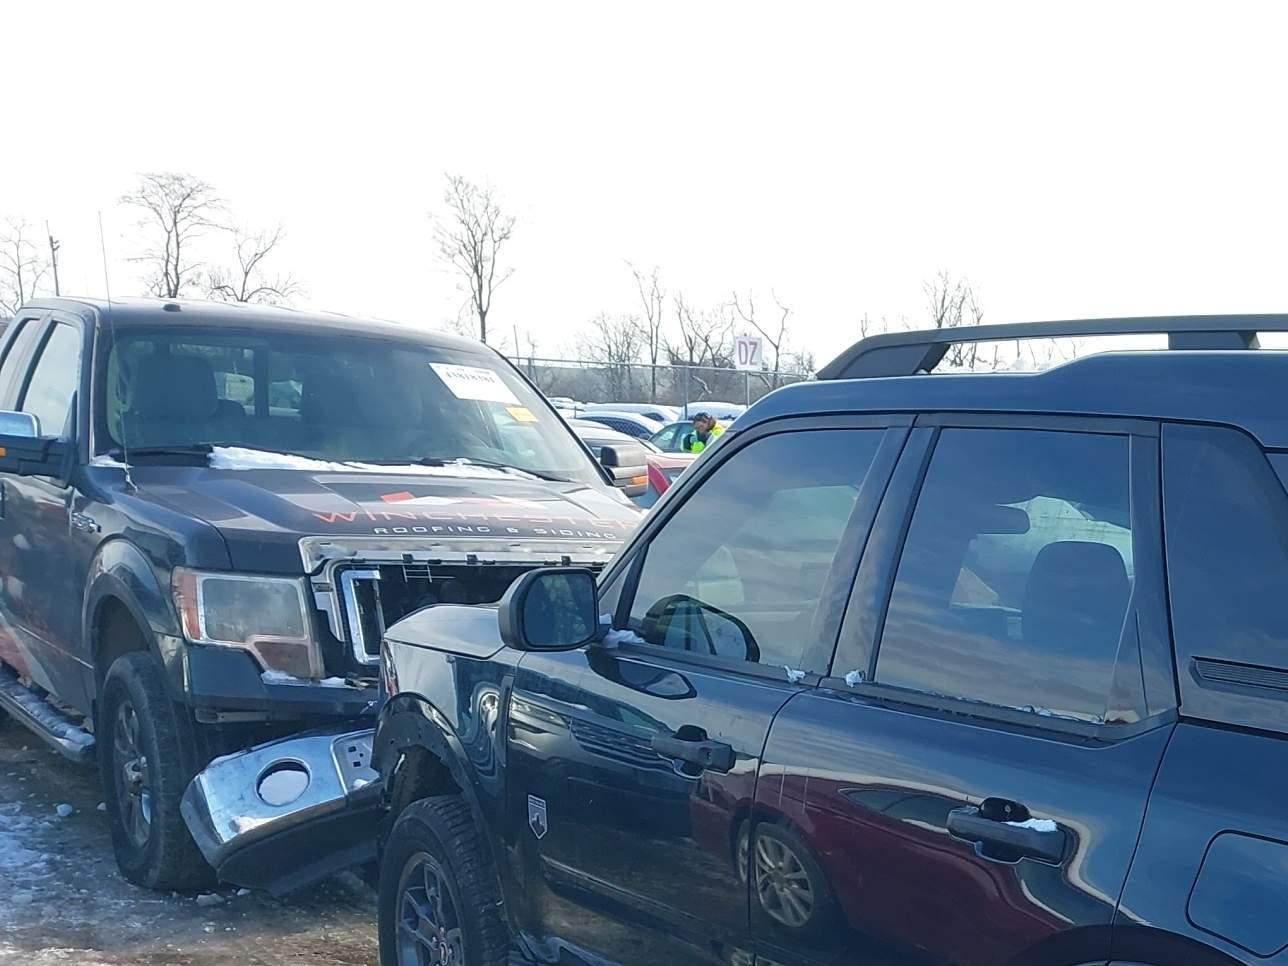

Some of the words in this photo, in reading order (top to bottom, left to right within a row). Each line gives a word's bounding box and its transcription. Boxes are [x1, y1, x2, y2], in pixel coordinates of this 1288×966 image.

[373, 524, 491, 535] ROOFING
[506, 526, 519, 534] &
[533, 527, 617, 539] SIDING
